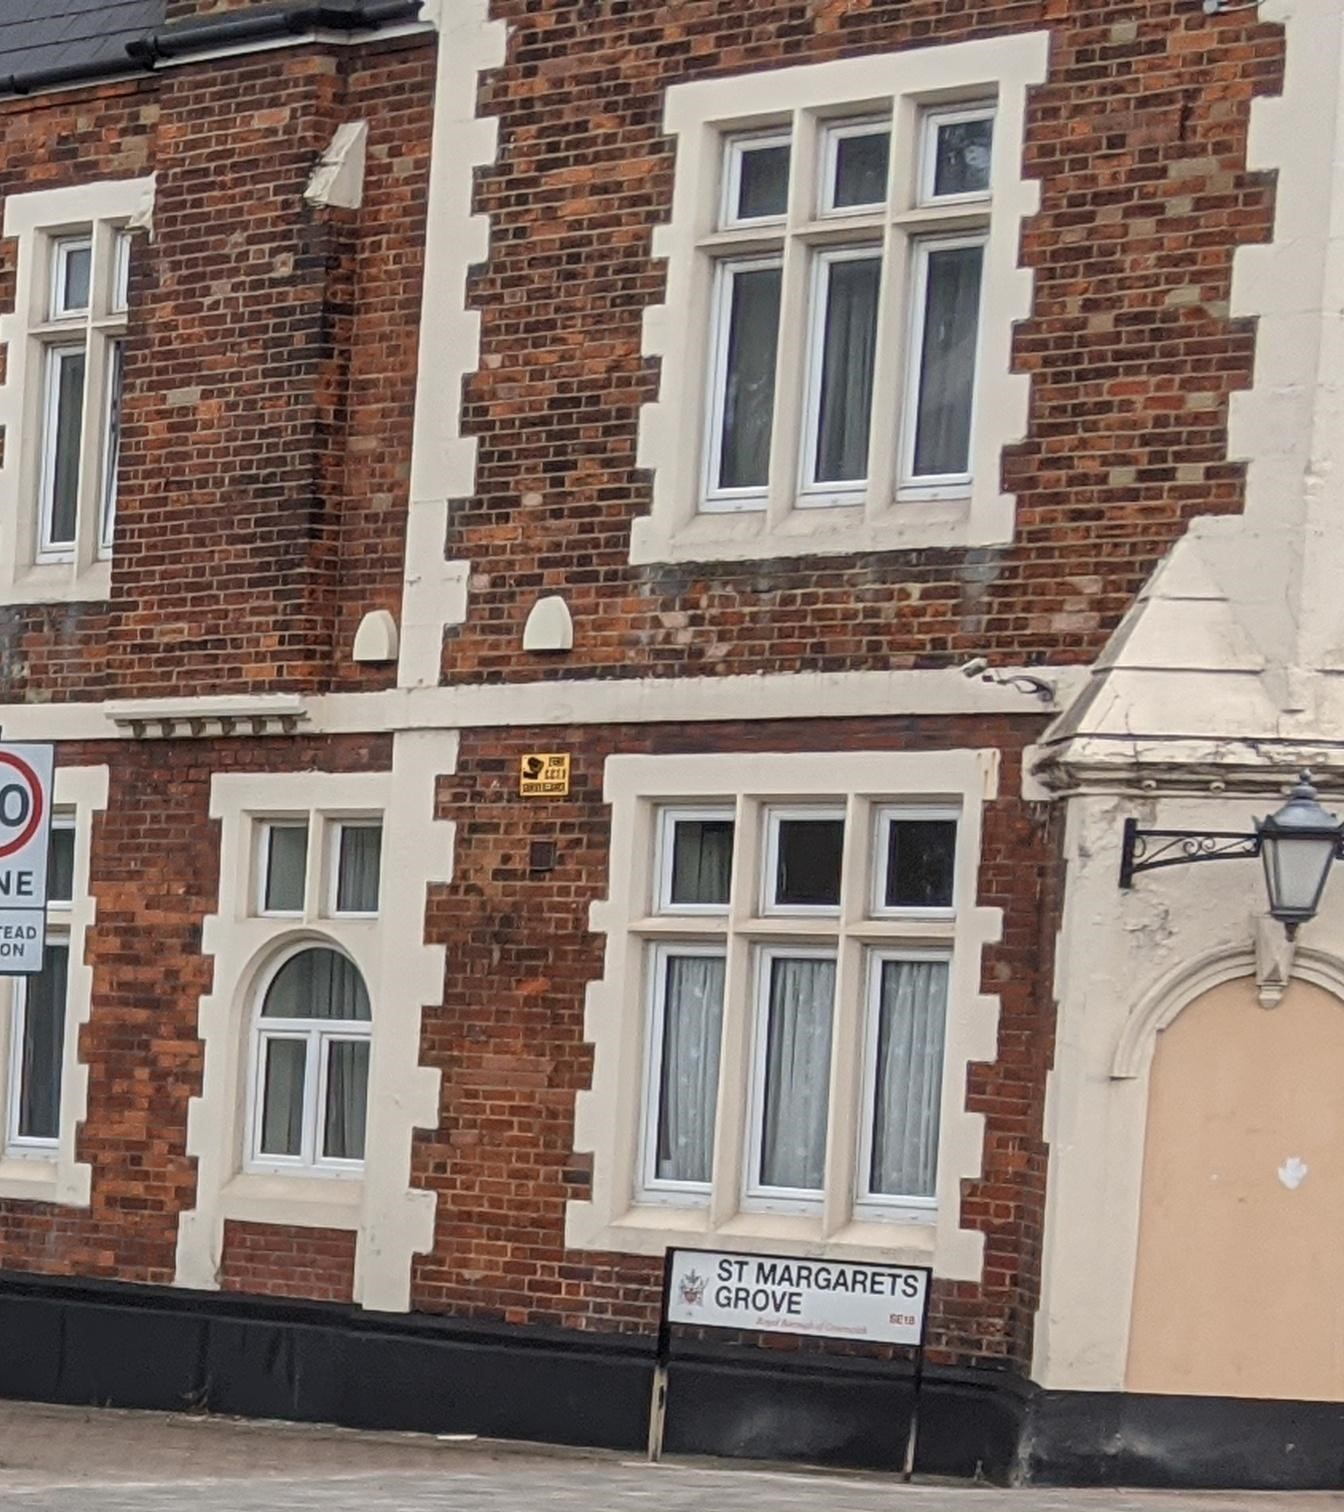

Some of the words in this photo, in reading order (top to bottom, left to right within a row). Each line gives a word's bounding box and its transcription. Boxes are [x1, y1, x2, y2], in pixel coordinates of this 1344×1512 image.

[717, 1258, 750, 1283] ST
[755, 1262, 919, 1298] MARGARETS
[714, 1286, 803, 1315] GROVE
